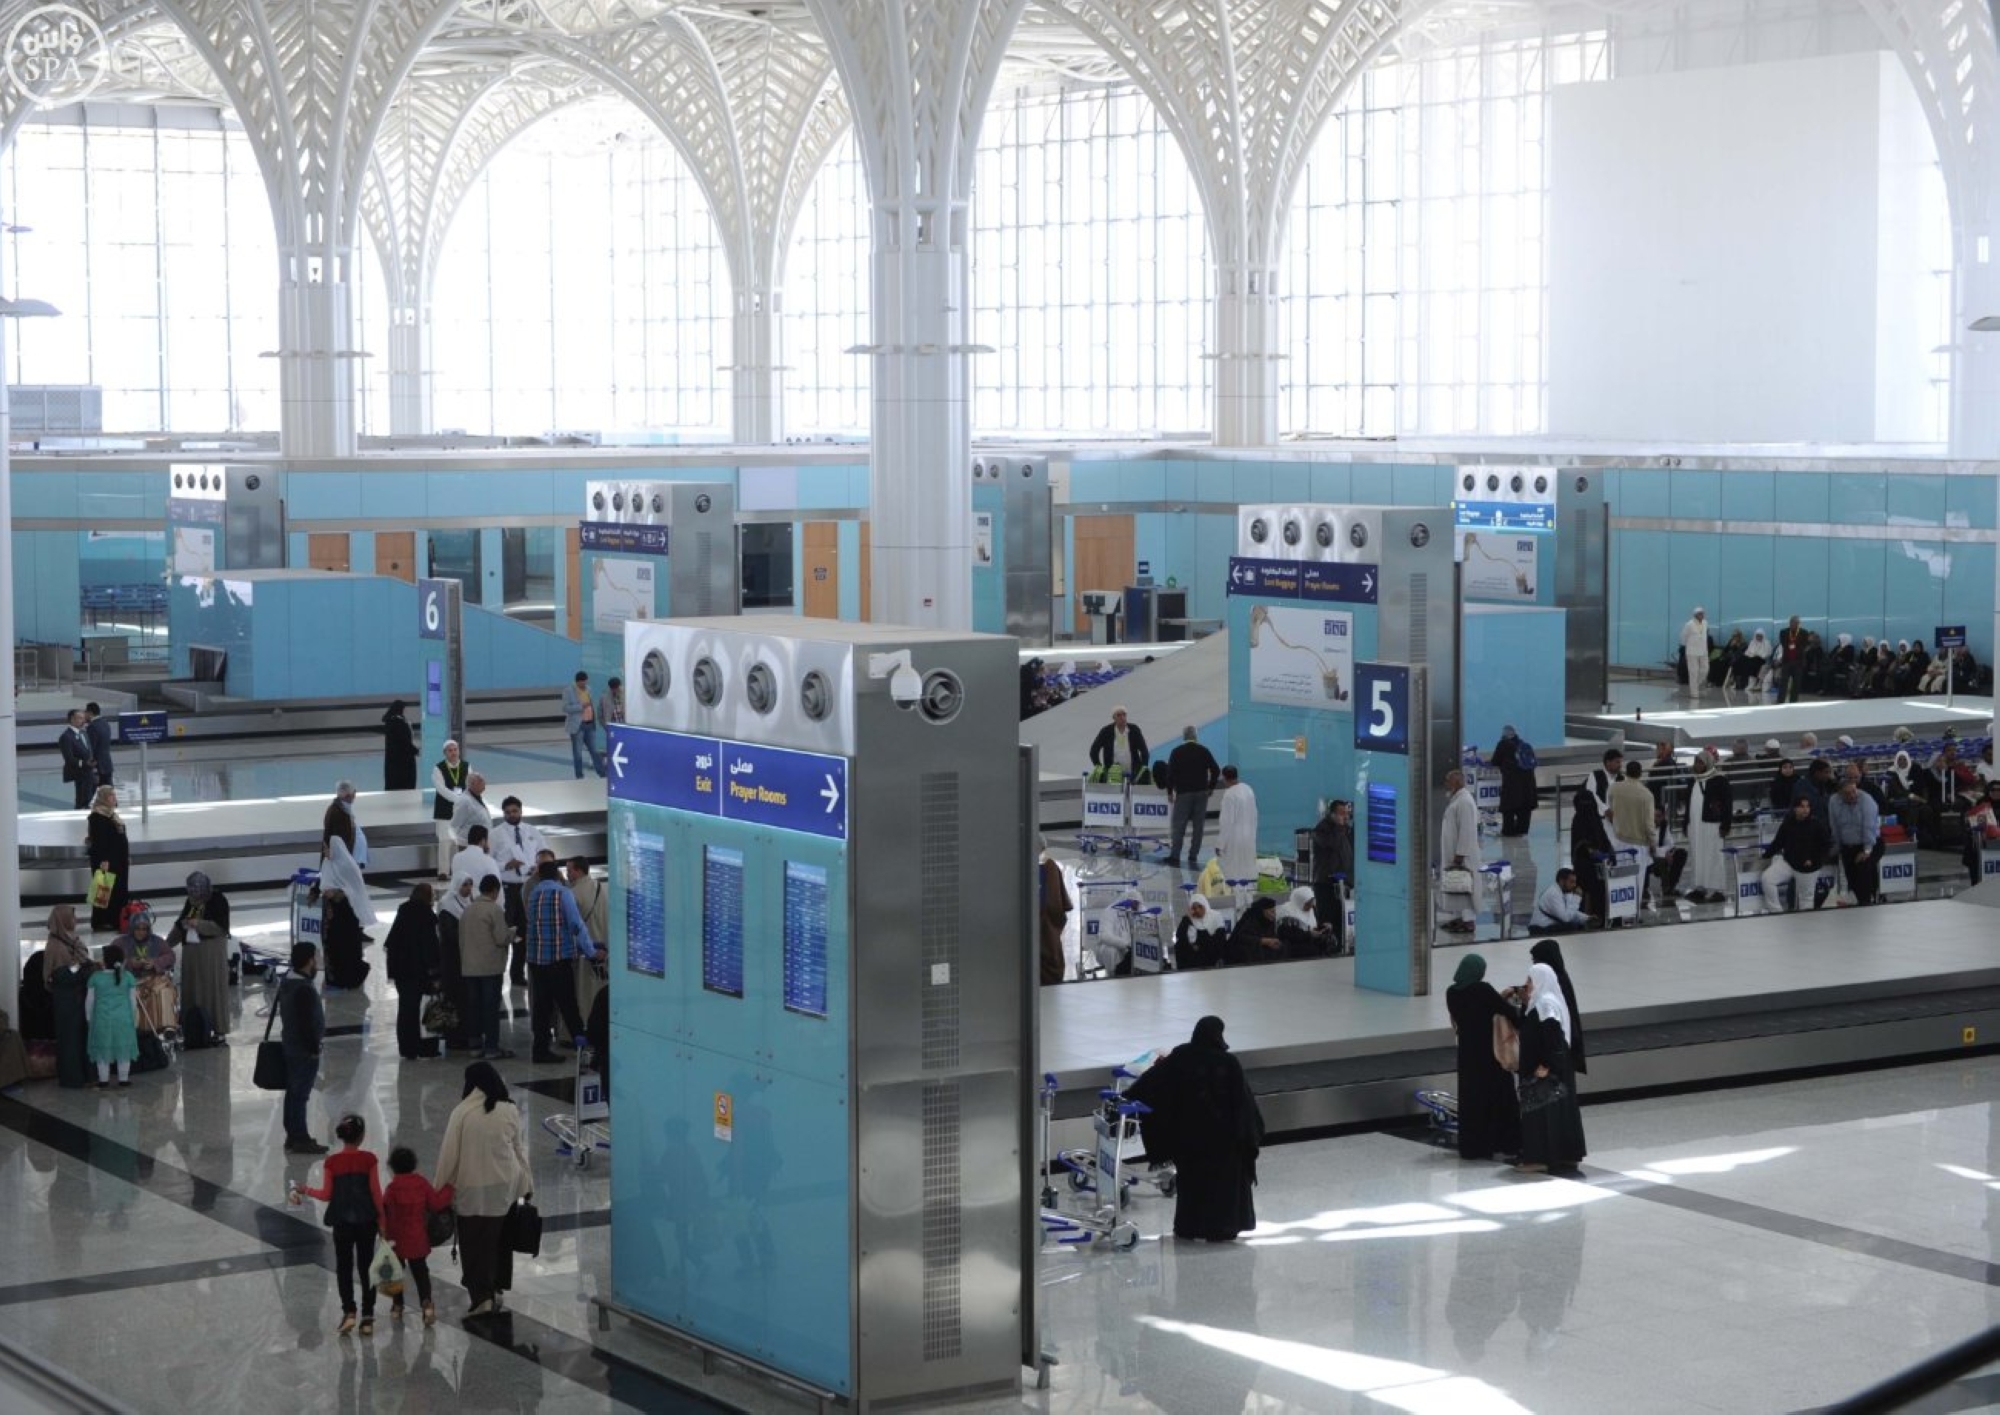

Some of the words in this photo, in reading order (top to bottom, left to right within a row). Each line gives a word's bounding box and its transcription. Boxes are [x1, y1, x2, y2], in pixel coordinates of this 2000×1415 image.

[425, 590, 439, 631] 6
[1369, 680, 1394, 736] 5
[695, 753, 713, 770] خروج
[730, 756, 754, 774] مصلى
[696, 775, 712, 793] Exit
[730, 780, 757, 804] Prayer
[758, 785, 787, 806] Rooms
[1089, 803, 1119, 813] TAV
[1135, 804, 1167, 815] TAV
[1883, 865, 1912, 878] TAV
